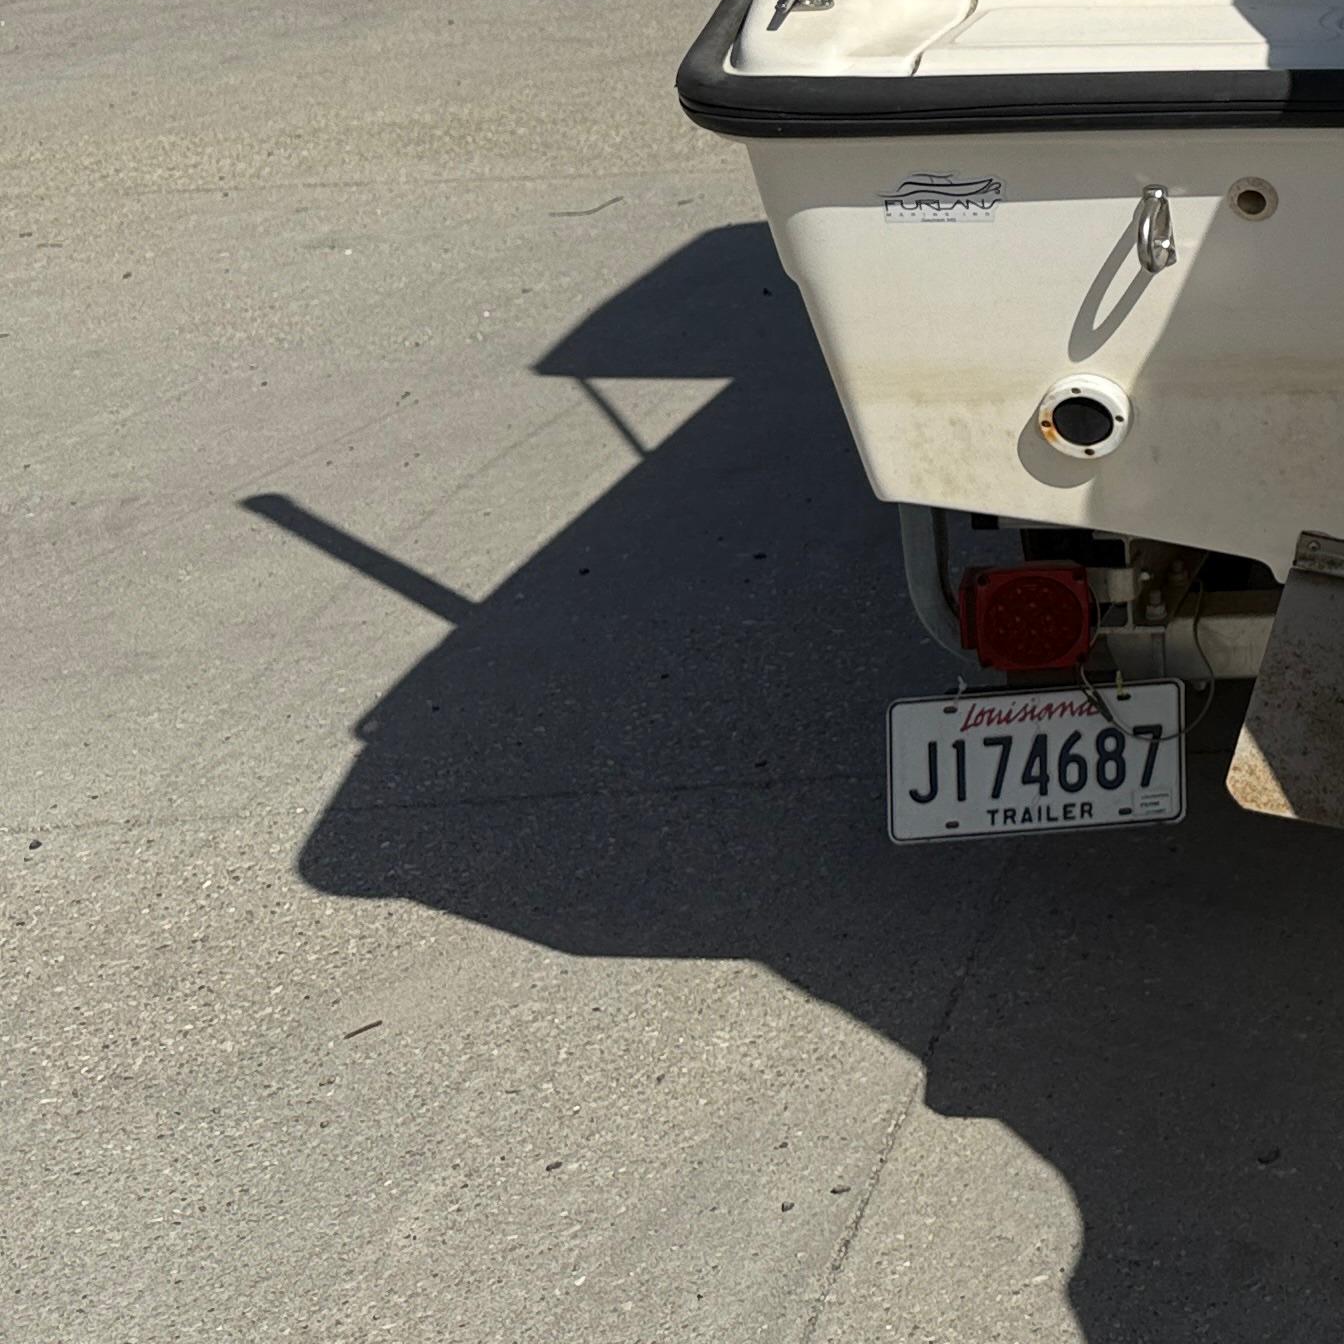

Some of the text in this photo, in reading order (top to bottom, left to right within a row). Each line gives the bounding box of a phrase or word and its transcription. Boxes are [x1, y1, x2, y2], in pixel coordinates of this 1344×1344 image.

[960, 698, 1100, 732] Louisiana
[908, 724, 1163, 803] J174687
[986, 802, 1094, 826] TRAILER
